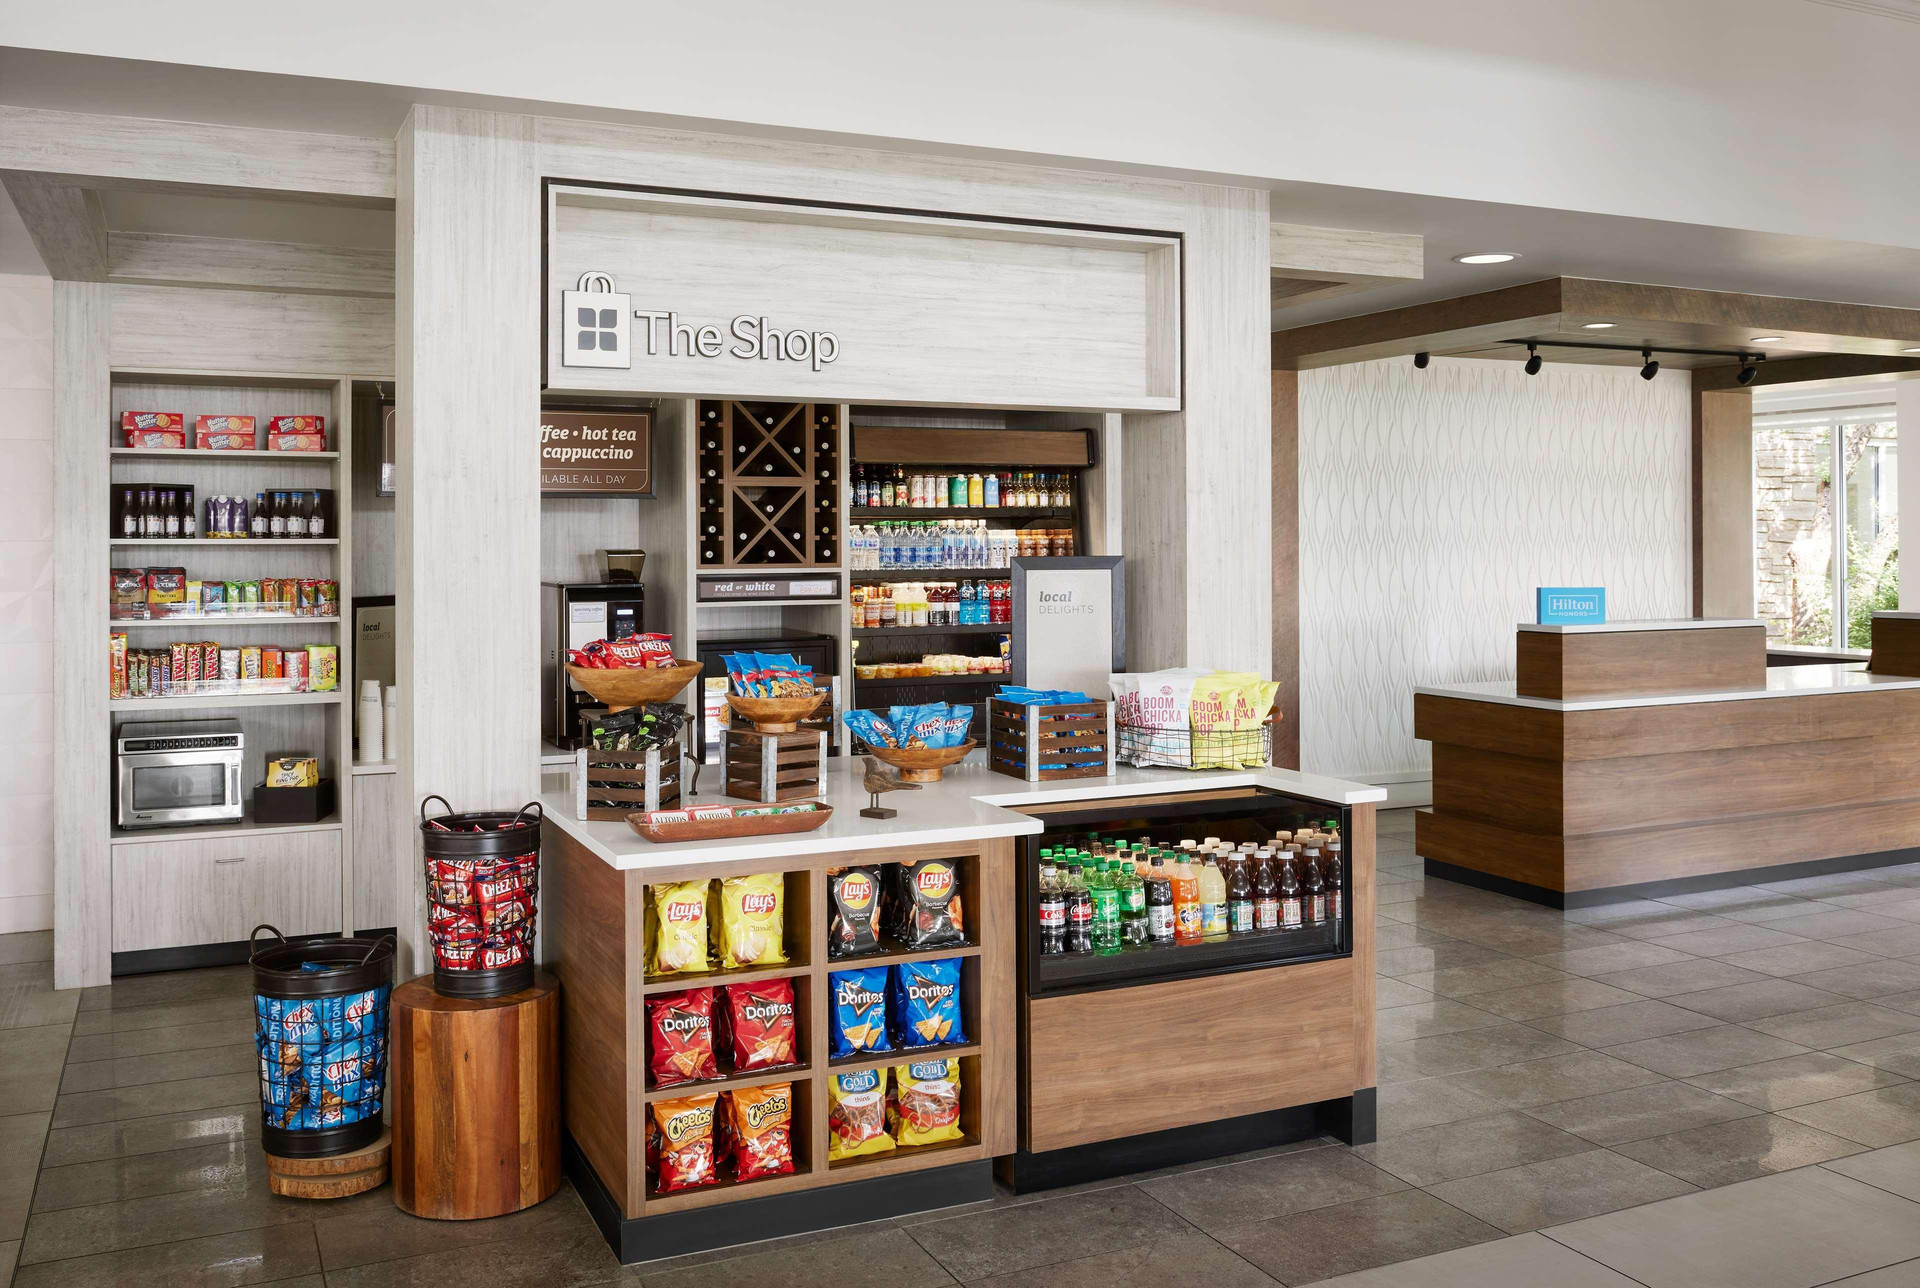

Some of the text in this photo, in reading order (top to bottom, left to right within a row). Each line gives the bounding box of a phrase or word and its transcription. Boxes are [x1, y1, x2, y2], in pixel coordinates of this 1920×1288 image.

[634, 310, 840, 372] The Shop
[540, 425, 636, 443] ffee hot tea
[543, 444, 634, 462] cappuccino
[542, 474, 626, 484] ILABLE ALL DAY
[714, 582, 733, 592] red
[746, 582, 776, 592] white
[1040, 591, 1072, 602] local
[1552, 598, 1594, 610] Hilton
[1039, 605, 1094, 614] DELIGHTS
[362, 622, 380, 632] local
[362, 632, 392, 641] DELIGHTS
[1144, 697, 1174, 710] BOOM
[1192, 700, 1222, 712] BOOM
[914, 716, 942, 732] Chex
[1144, 710, 1182, 723] CHICKA
[1194, 710, 1231, 724] CHICKA
[920, 870, 950, 890] Lay's
[843, 880, 870, 900] Lay's
[670, 902, 701, 922] Lay's
[744, 894, 774, 914] Lay's
[839, 992, 884, 1006] Doritos
[910, 984, 954, 1000] Doritos
[284, 1003, 314, 1030] Chex
[746, 1004, 792, 1020] Doritos
[664, 1016, 710, 1032] Doritos
[327, 1056, 359, 1079] Chex
[913, 1063, 947, 1078] GOLD
[843, 1075, 875, 1090] GOLD
[749, 1098, 788, 1128] Cheetos
[668, 1109, 712, 1140] Cheetos
